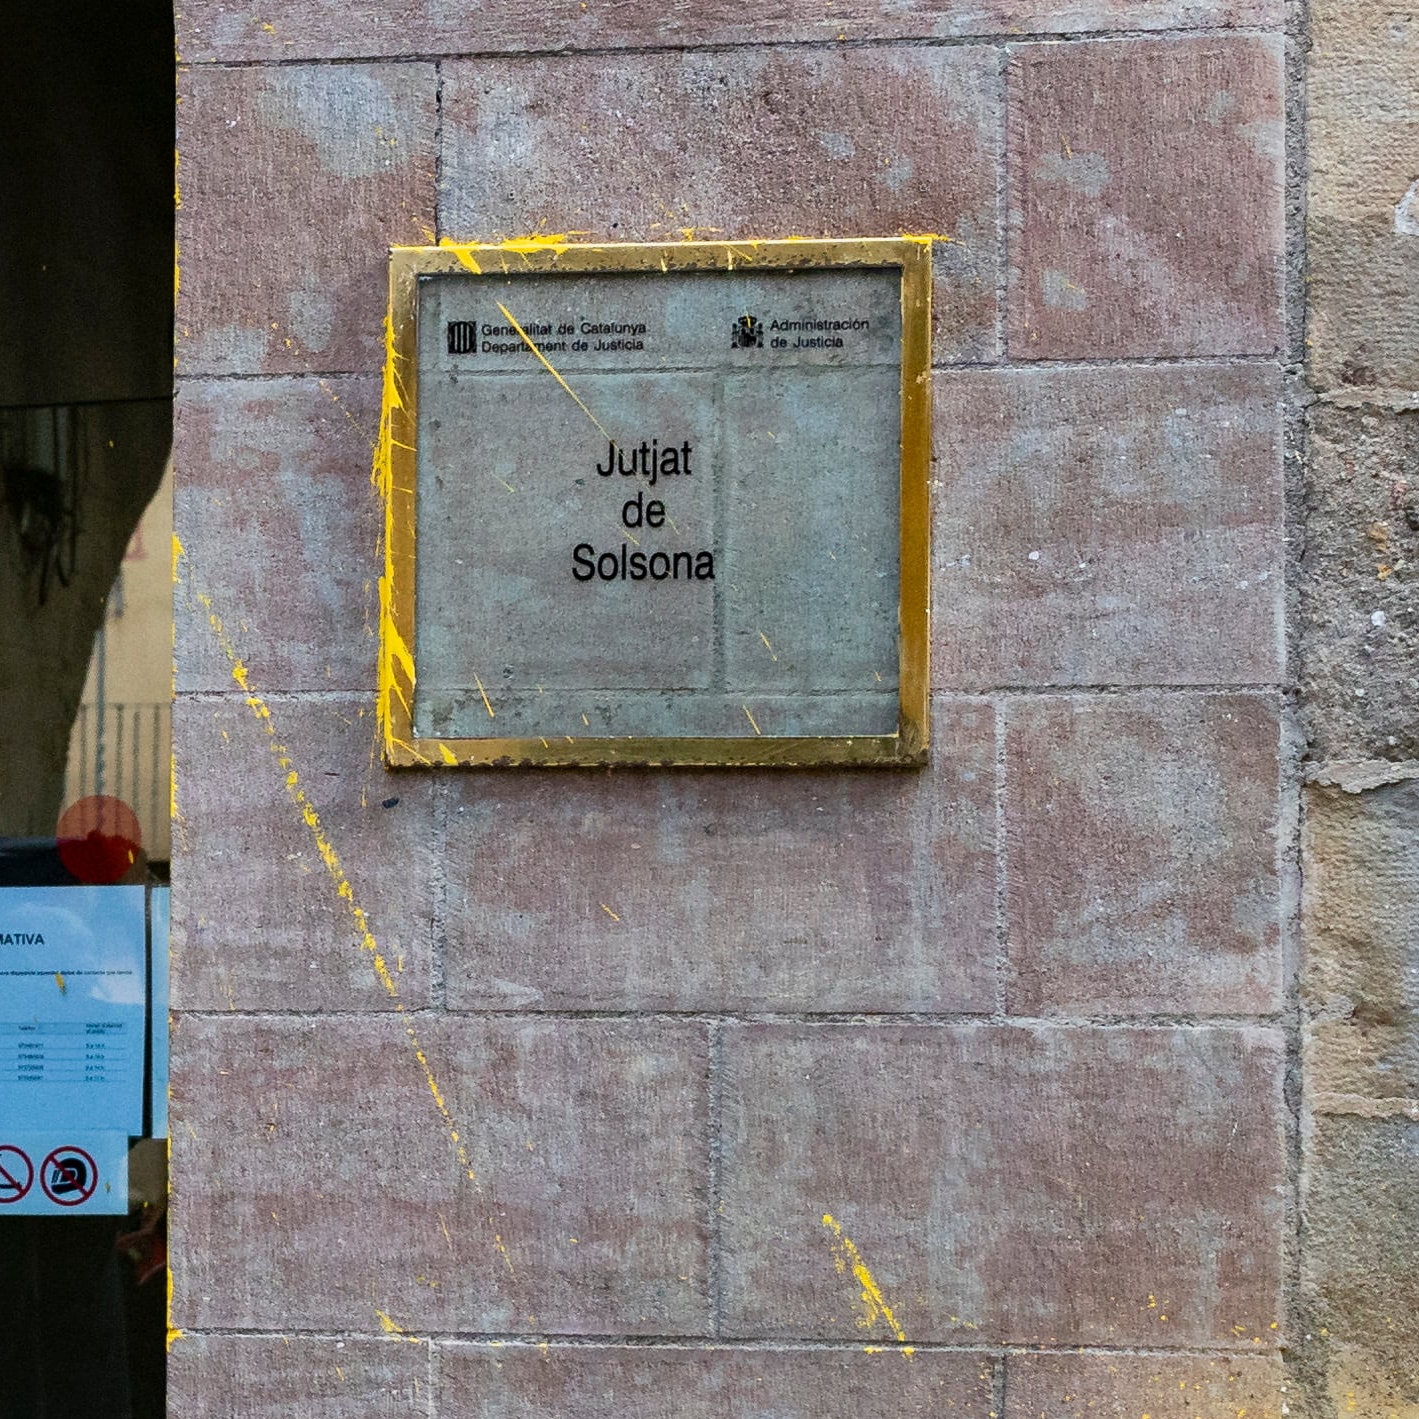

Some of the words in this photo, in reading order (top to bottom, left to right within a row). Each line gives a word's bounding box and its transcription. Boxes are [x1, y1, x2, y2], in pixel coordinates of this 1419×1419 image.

[482, 324, 552, 336] Genealitat
[558, 323, 575, 335] de
[581, 322, 647, 336] Catalunya
[770, 318, 870, 331] Administración
[571, 339, 588, 351] de
[770, 337, 788, 348] de
[793, 336, 844, 348] Justicia
[596, 439, 692, 485] Jutjat
[622, 491, 666, 528] de
[572, 543, 715, 581] Solsona
